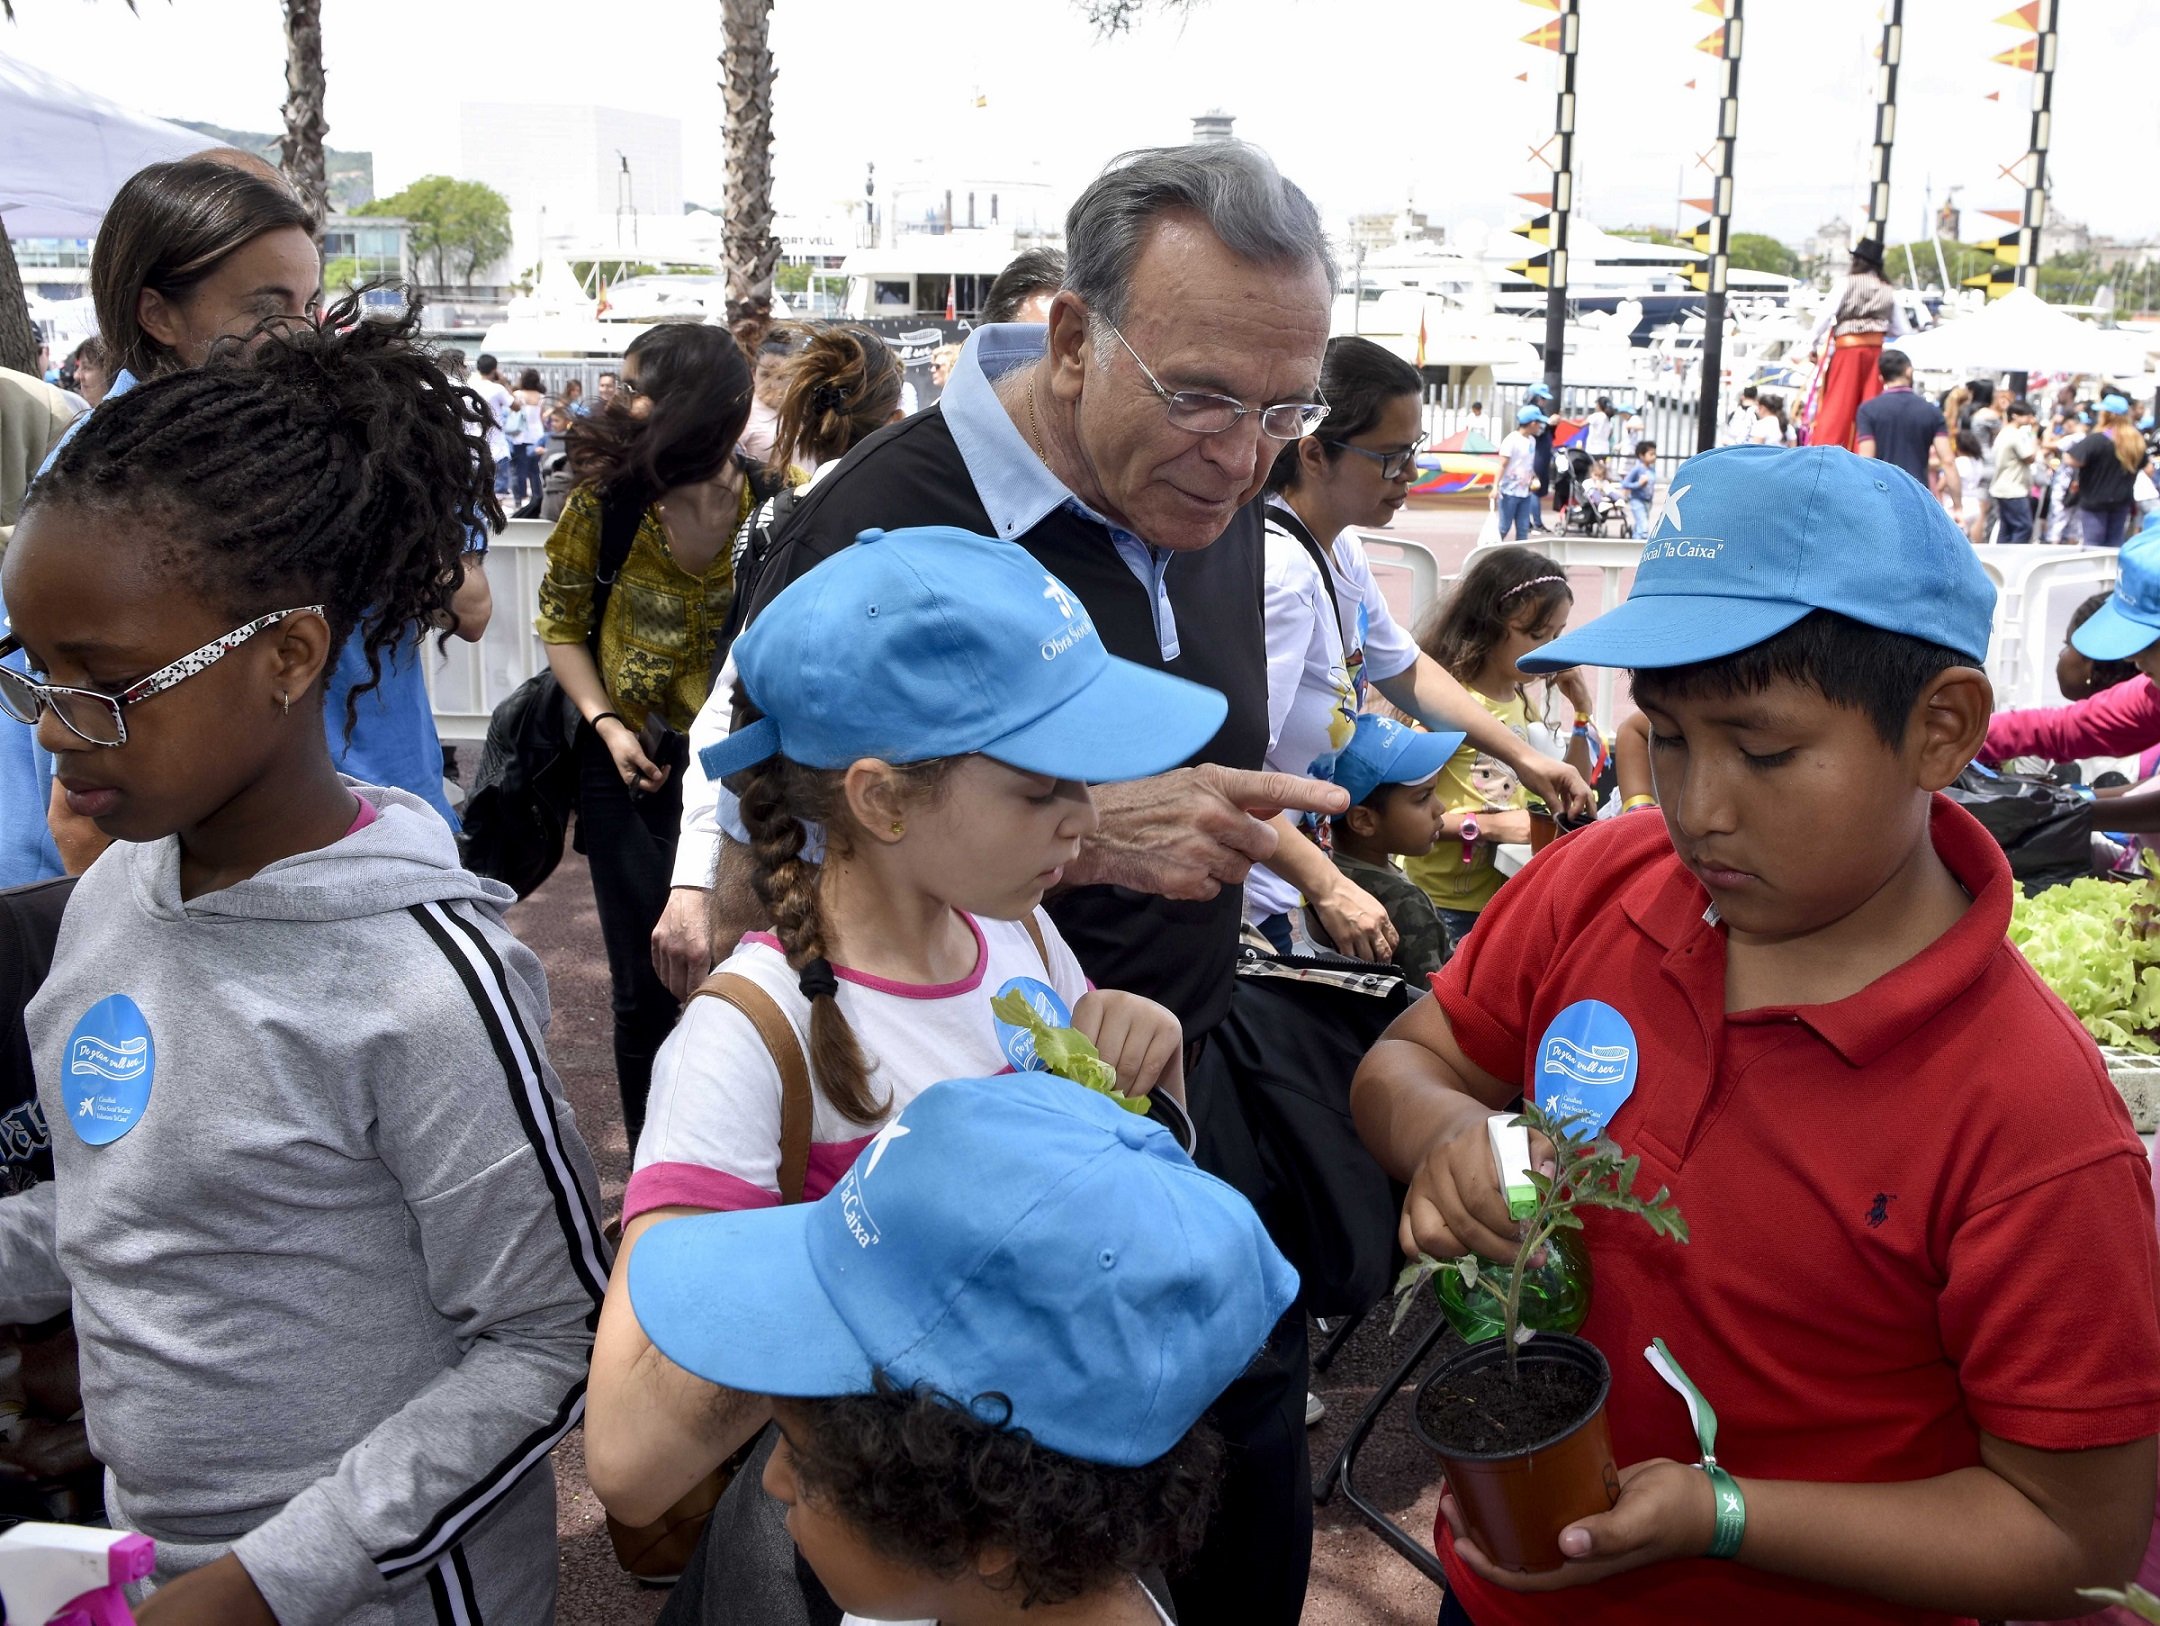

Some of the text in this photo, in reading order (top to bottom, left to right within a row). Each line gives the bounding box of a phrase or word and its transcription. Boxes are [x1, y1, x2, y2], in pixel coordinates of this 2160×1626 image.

[781, 236, 834, 246] ORT VELL
[1677, 540, 1724, 559] Caixa"
[1042, 635, 1073, 660] Obra
[88, 1050, 109, 1062] gran
[110, 1057, 126, 1069] vull
[1552, 1046, 1561, 1056] De
[1559, 1051, 1577, 1063] gran
[1577, 1061, 1598, 1073] vull
[844, 1195, 879, 1248] Caixa"
